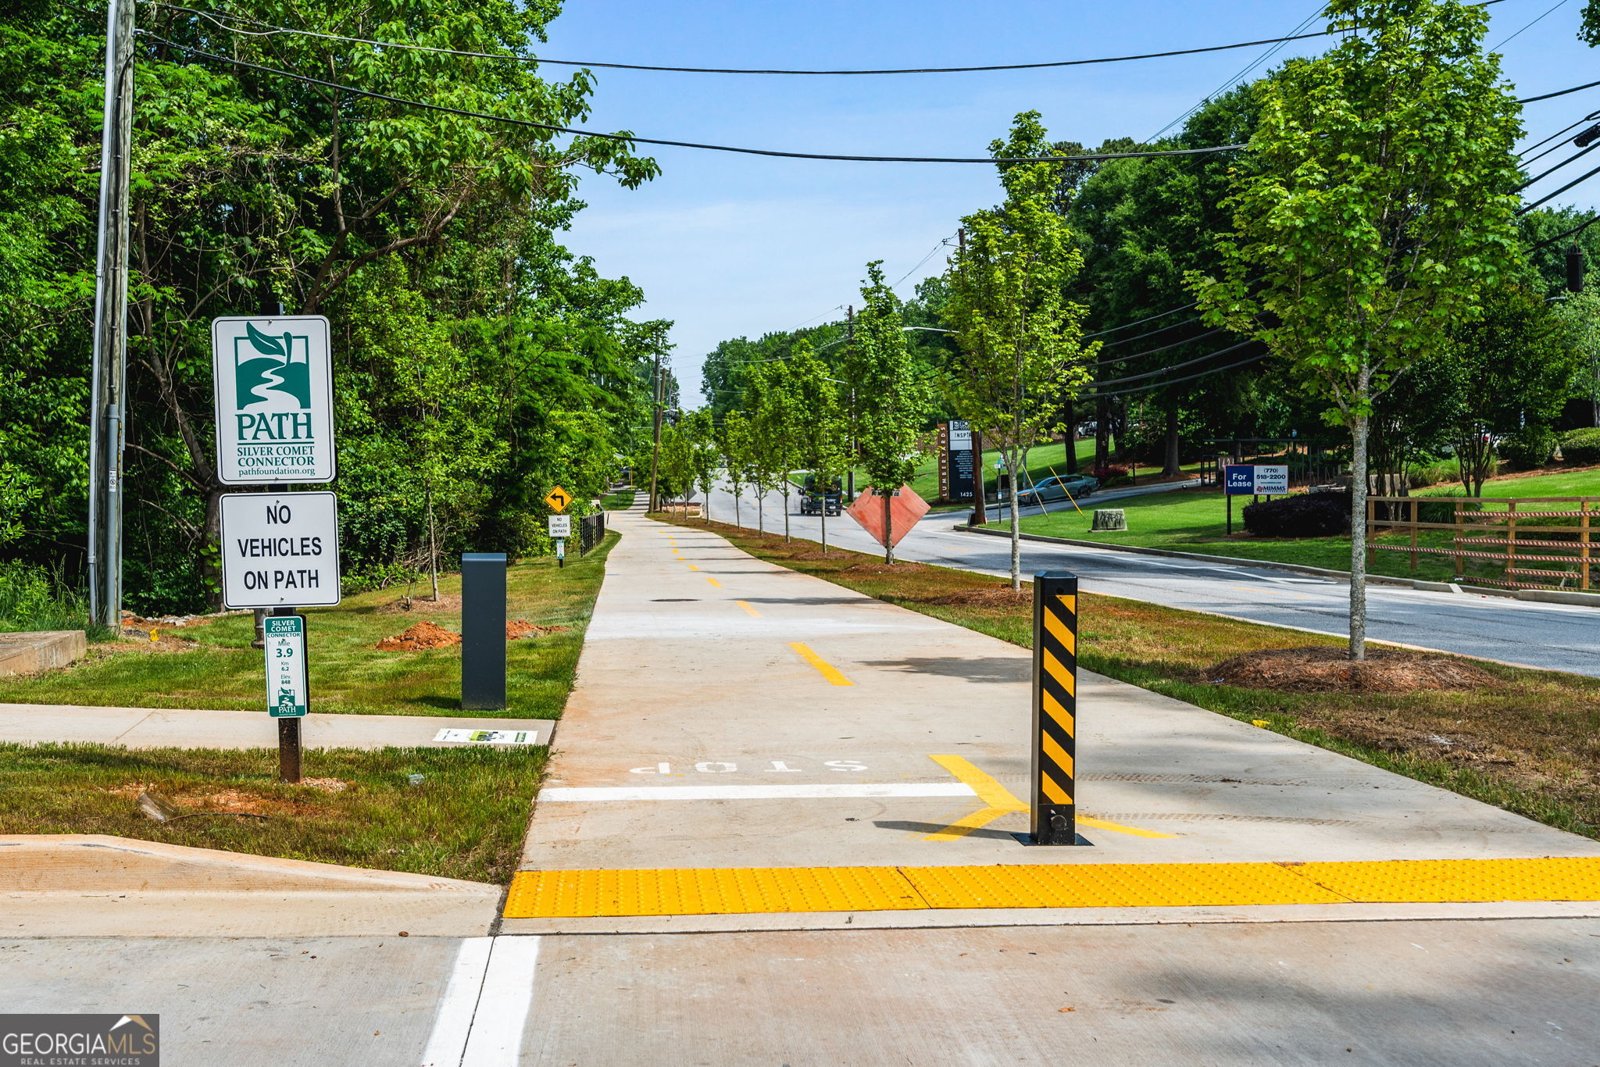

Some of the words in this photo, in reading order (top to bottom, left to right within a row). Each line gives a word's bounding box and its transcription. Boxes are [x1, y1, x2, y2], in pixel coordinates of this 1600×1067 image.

[235, 412, 314, 441] PATH
[237, 446, 273, 457] SILVER
[276, 445, 314, 456] COMET
[238, 456, 315, 467] CONNECTOR
[238, 466, 316, 478] pathfoundation.org
[266, 504, 292, 524] NO
[237, 536, 322, 558] VEHICLES
[244, 570, 268, 590] ON
[274, 569, 319, 589] PATH
[276, 648, 293, 658] 3.9
[629, 760, 868, 774] STOP
